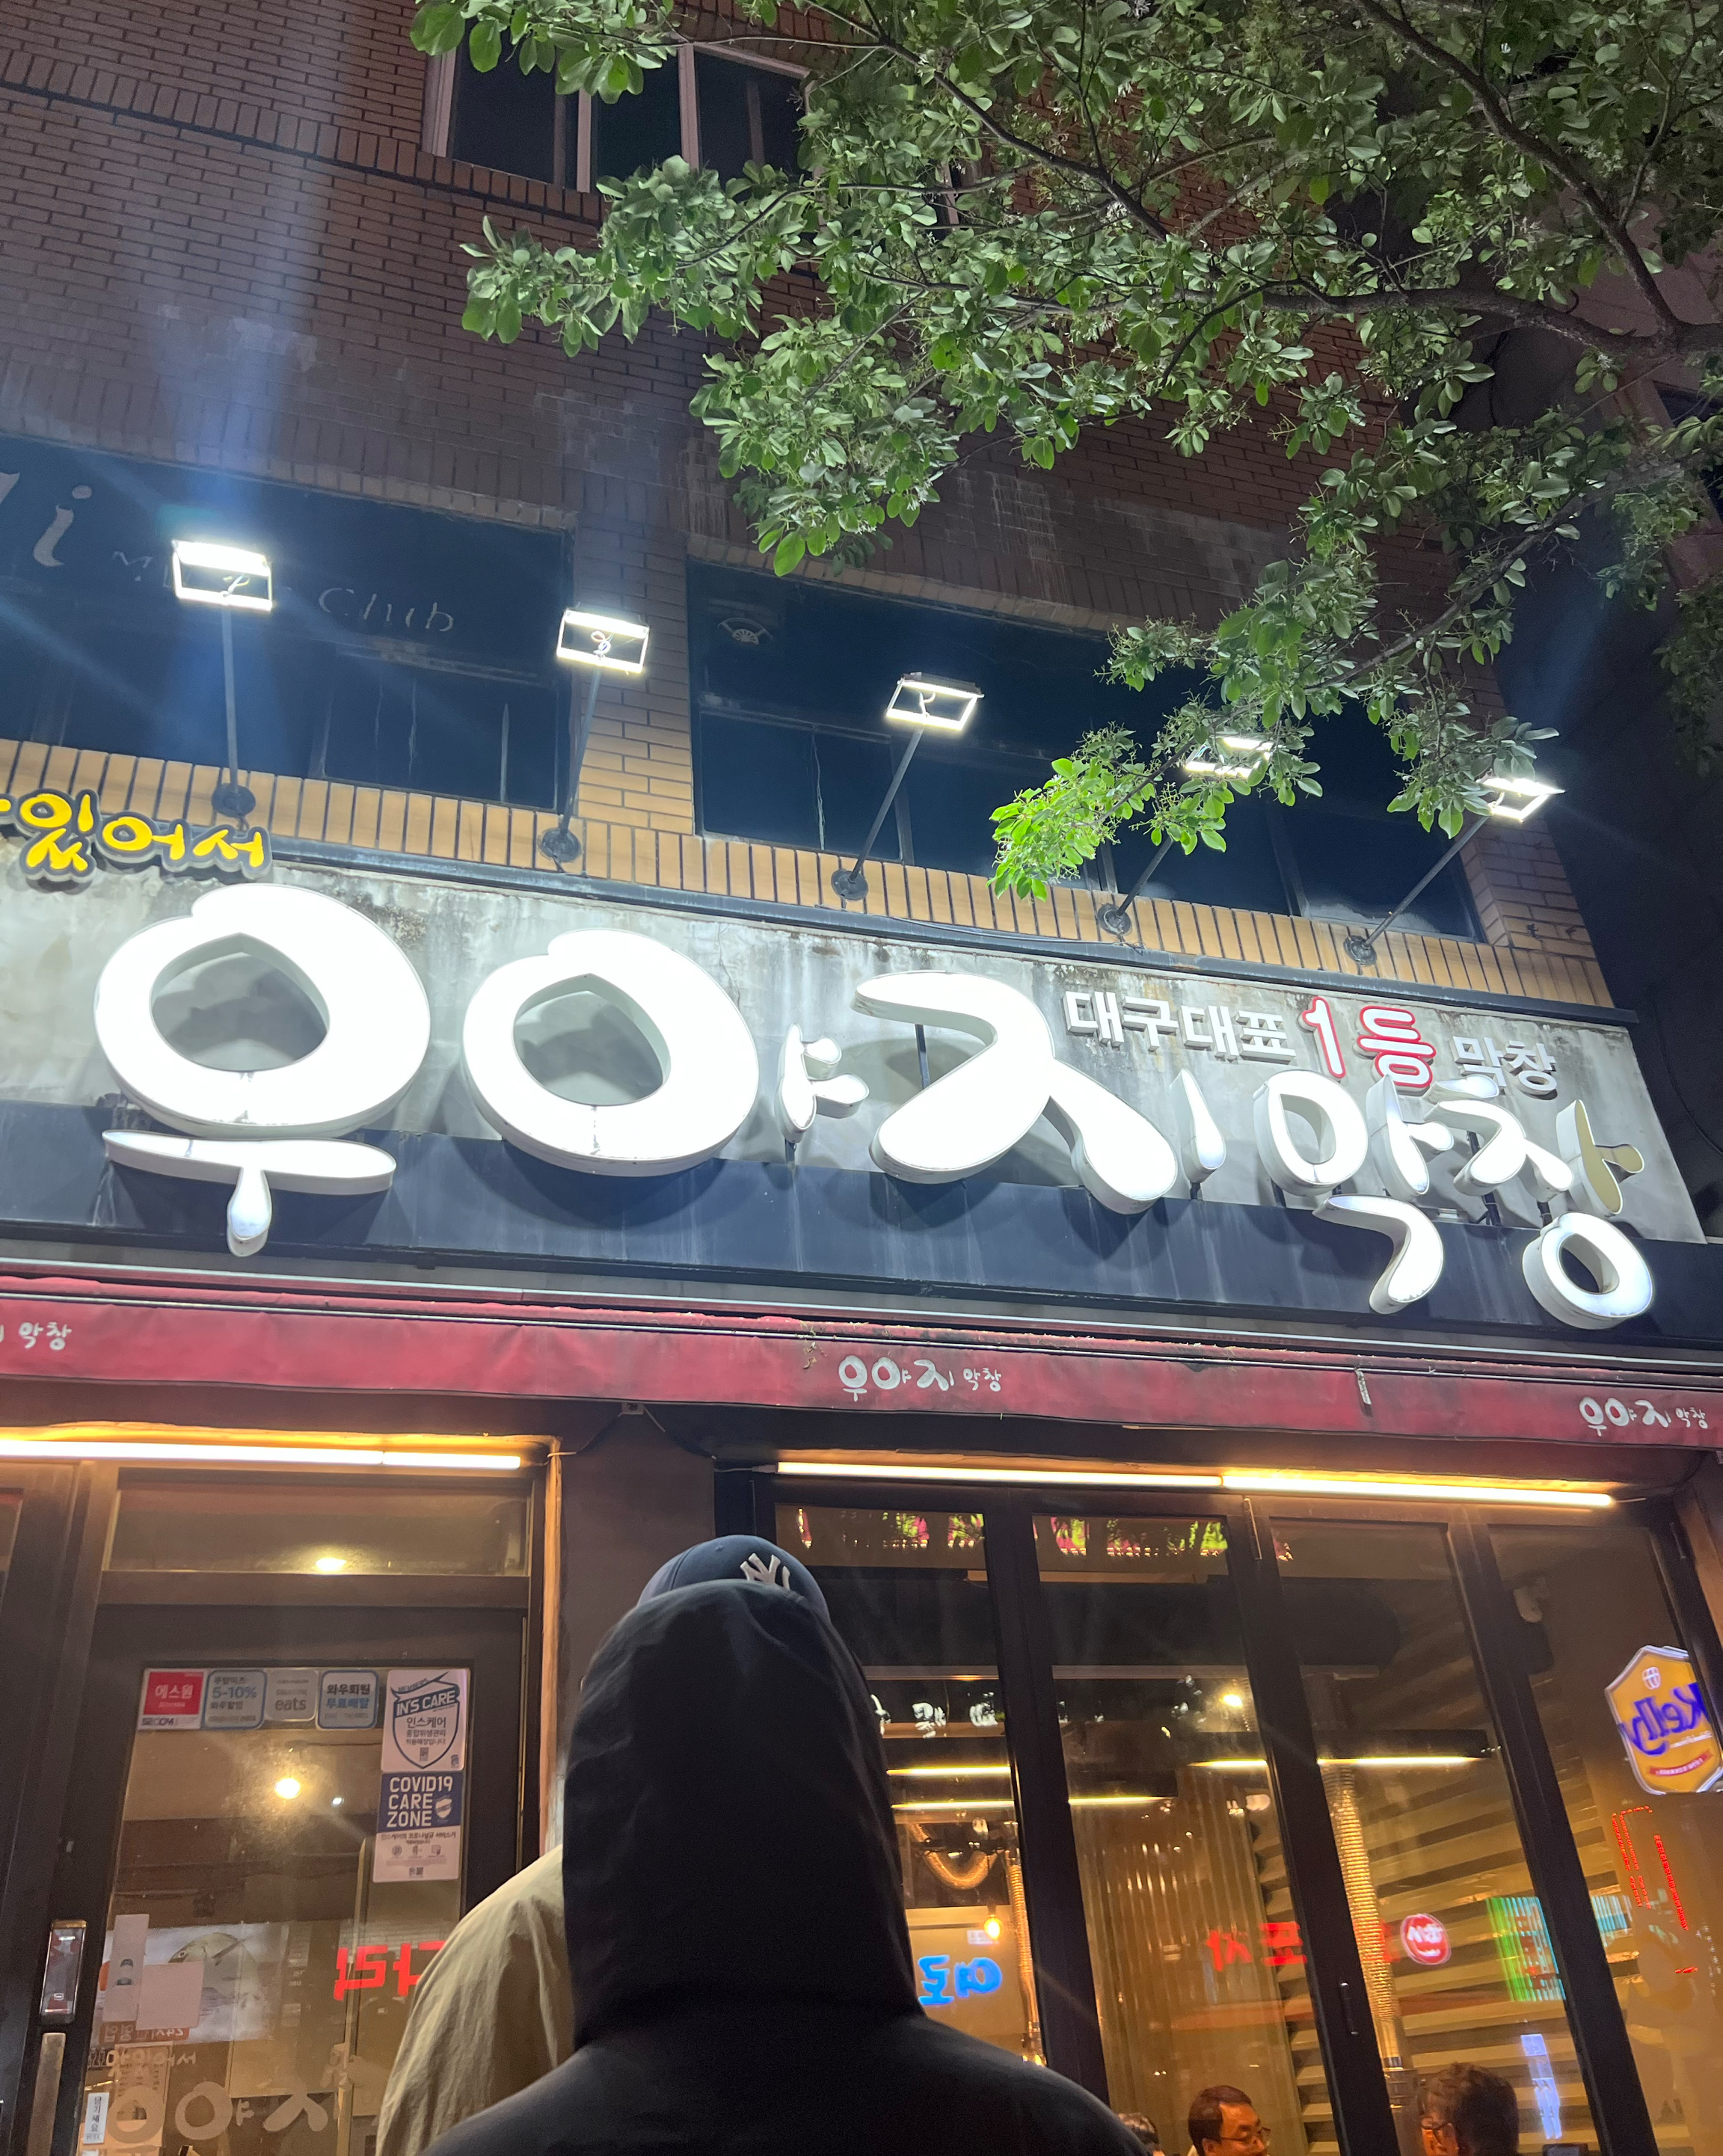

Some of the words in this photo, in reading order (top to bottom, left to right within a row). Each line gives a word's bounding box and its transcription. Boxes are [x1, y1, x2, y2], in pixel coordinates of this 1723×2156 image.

[319, 587, 455, 633] Club
[0, 791, 265, 875] 있어서
[1063, 991, 1297, 1063] 대구대표
[1299, 995, 1437, 1095] 1등
[1449, 1035, 1558, 1098] 막창
[94, 882, 1226, 1257] 우야지
[838, 1354, 955, 1402] 우야지
[1579, 1396, 1672, 1437] 우야지
[155, 1683, 194, 1700] 에스원
[212, 1686, 257, 1698] 5-10%
[326, 1683, 371, 1695] 와우회원
[274, 1697, 307, 1711] eats
[396, 1698, 420, 1716] IN'S
[422, 1690, 456, 1710] CARE
[406, 1716, 447, 1729] 인스케어
[406, 1729, 446, 1738] 종합위생관리
[390, 1775, 453, 1793] COVID19
[388, 1793, 434, 1810] CARE
[386, 1810, 432, 1828] ZONE
[90, 2095, 102, 2133] 당기세요
